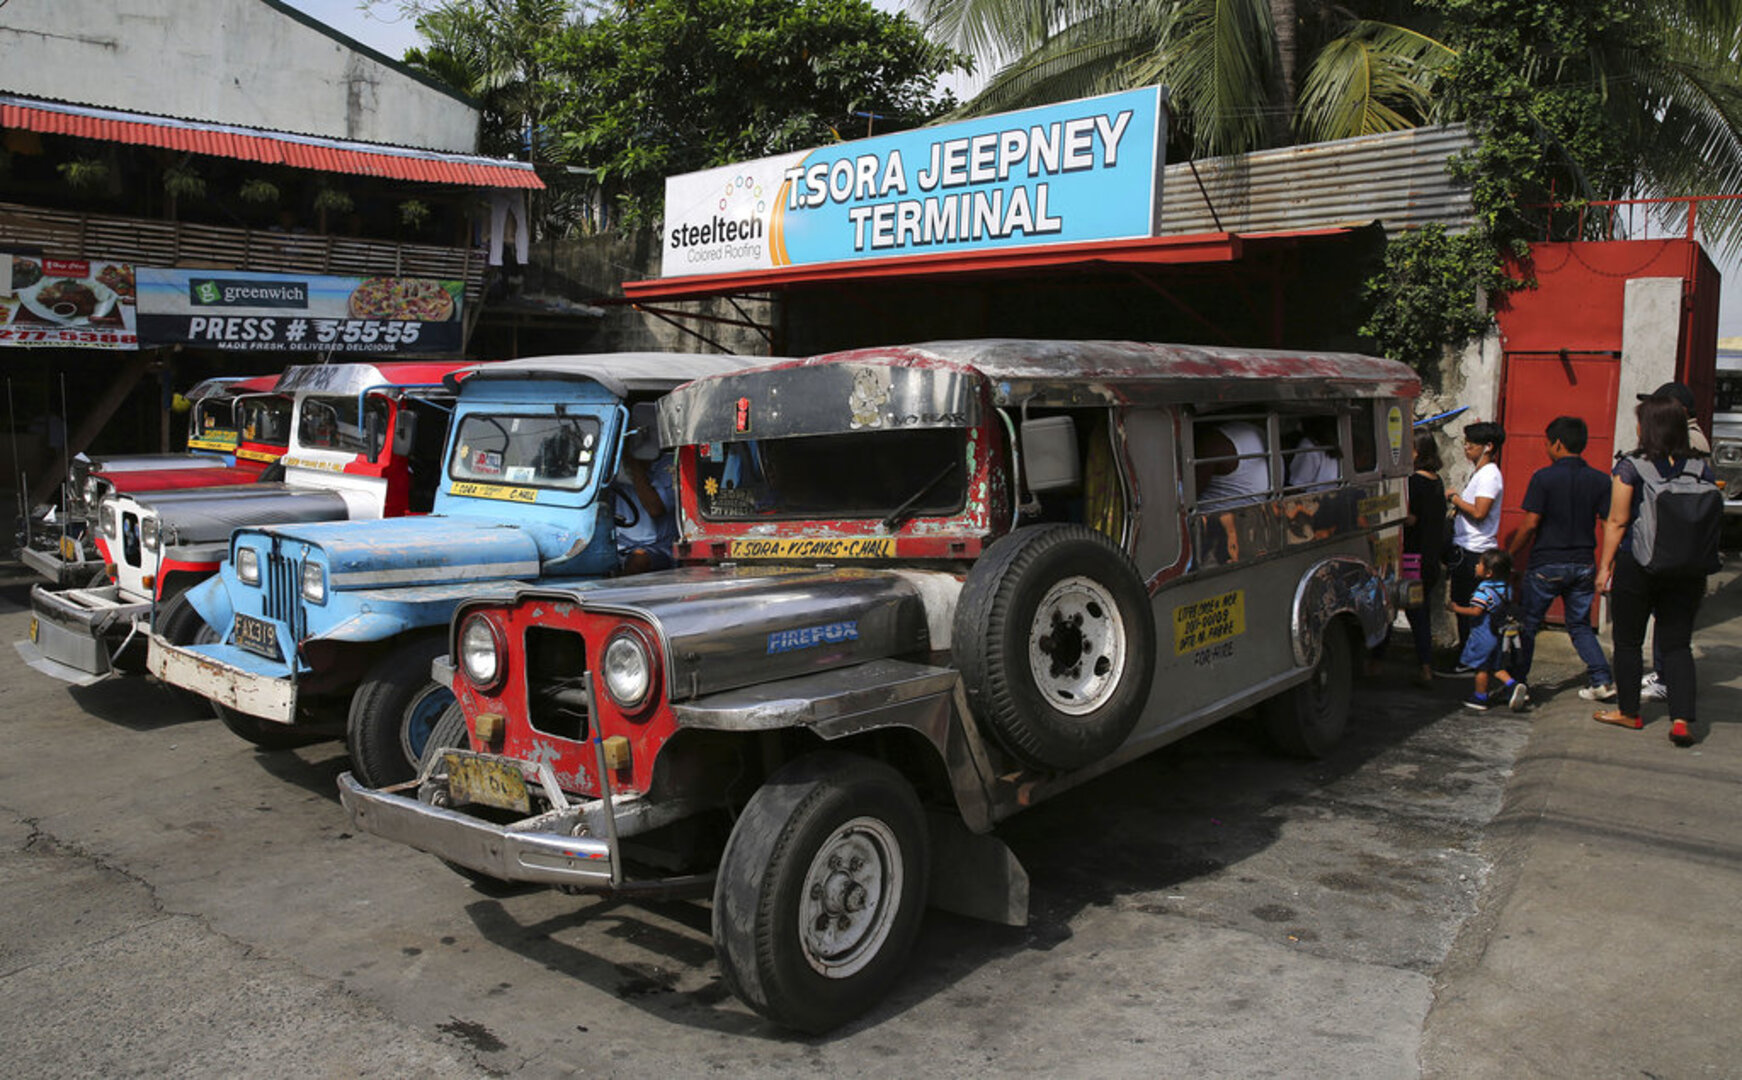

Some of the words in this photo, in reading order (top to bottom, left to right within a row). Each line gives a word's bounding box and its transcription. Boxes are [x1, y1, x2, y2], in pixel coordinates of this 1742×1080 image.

[918, 110, 1133, 191] JEEPNEY
[850, 182, 1062, 250] TERMINAL
[671, 211, 763, 249] steeltech
[687, 246, 722, 263] Colored
[725, 243, 762, 260] Roofing
[224, 284, 304, 302] greenwich
[188, 317, 276, 341] PRESS
[285, 319, 309, 341] #
[314, 319, 422, 344] 5-55-55
[217, 341, 247, 350] MADE
[290, 342, 343, 351] DELIVERED
[786, 541, 842, 557] VISAYAS
[769, 621, 858, 651] FIREFOX
